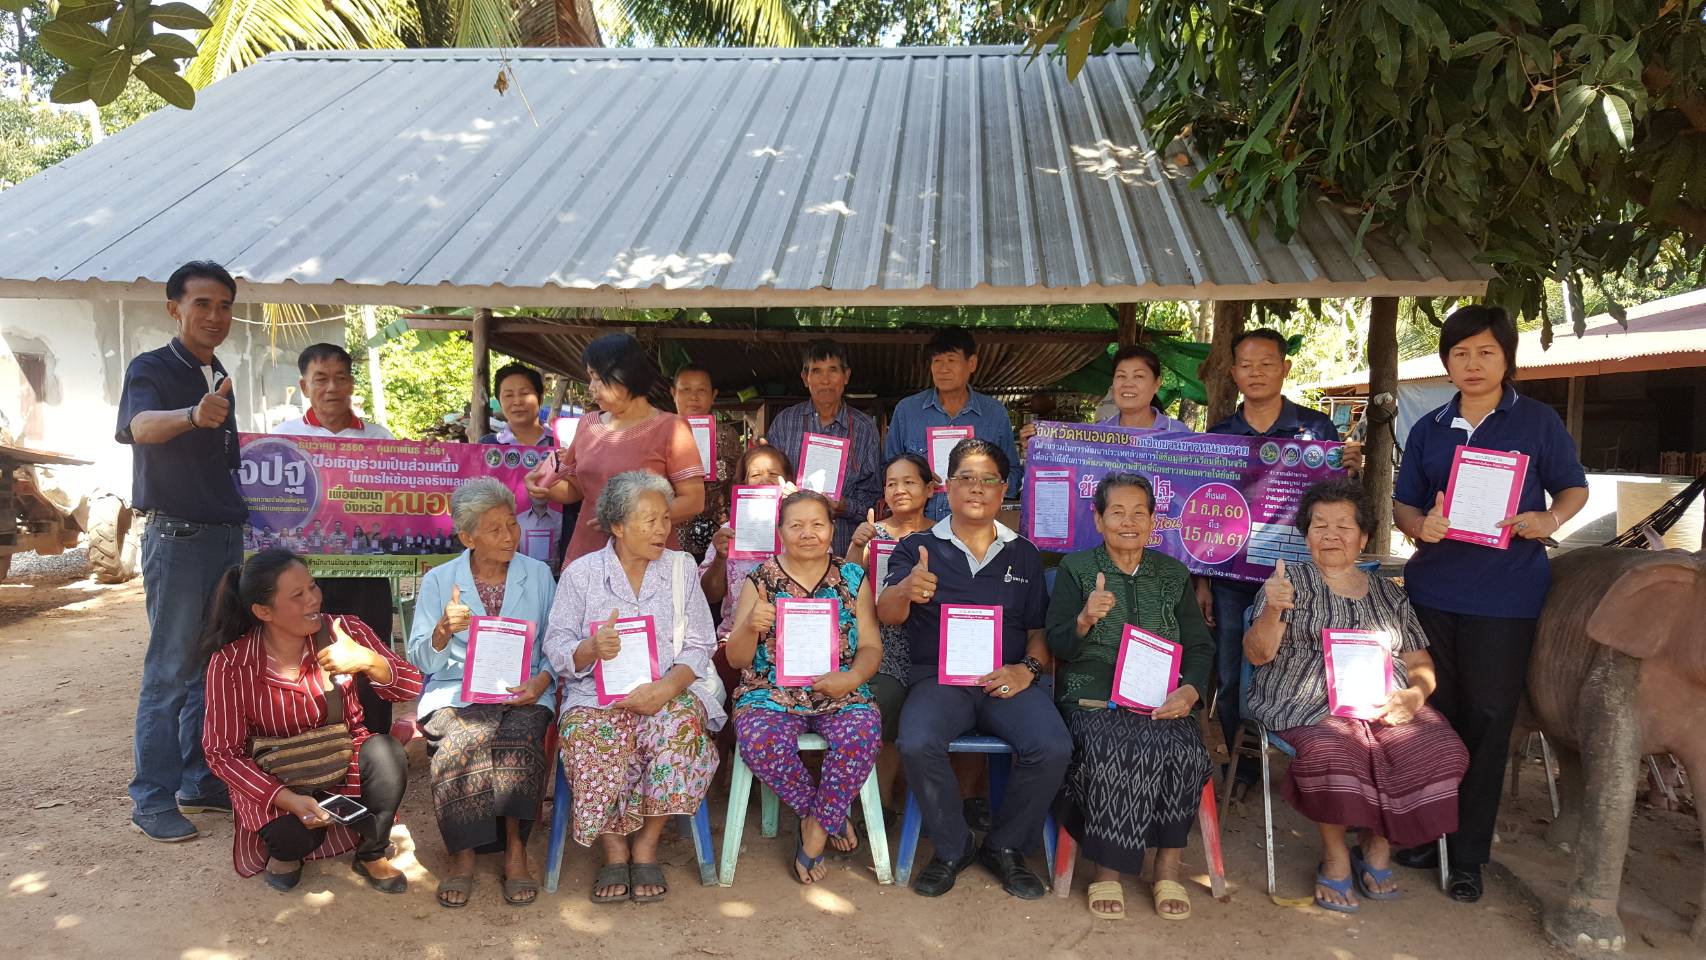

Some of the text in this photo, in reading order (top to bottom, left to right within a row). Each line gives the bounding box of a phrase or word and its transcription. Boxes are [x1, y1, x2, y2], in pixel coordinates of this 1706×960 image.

[340, 442, 364, 452] 2560
[424, 445, 445, 455] 2561
[312, 453, 459, 473] ขอเชิญร่วมเป็นส่วนหนึ่ง
[237, 455, 306, 495] จปฐ
[1189, 499, 1197, 514] 1
[1184, 526, 1201, 541] 15
